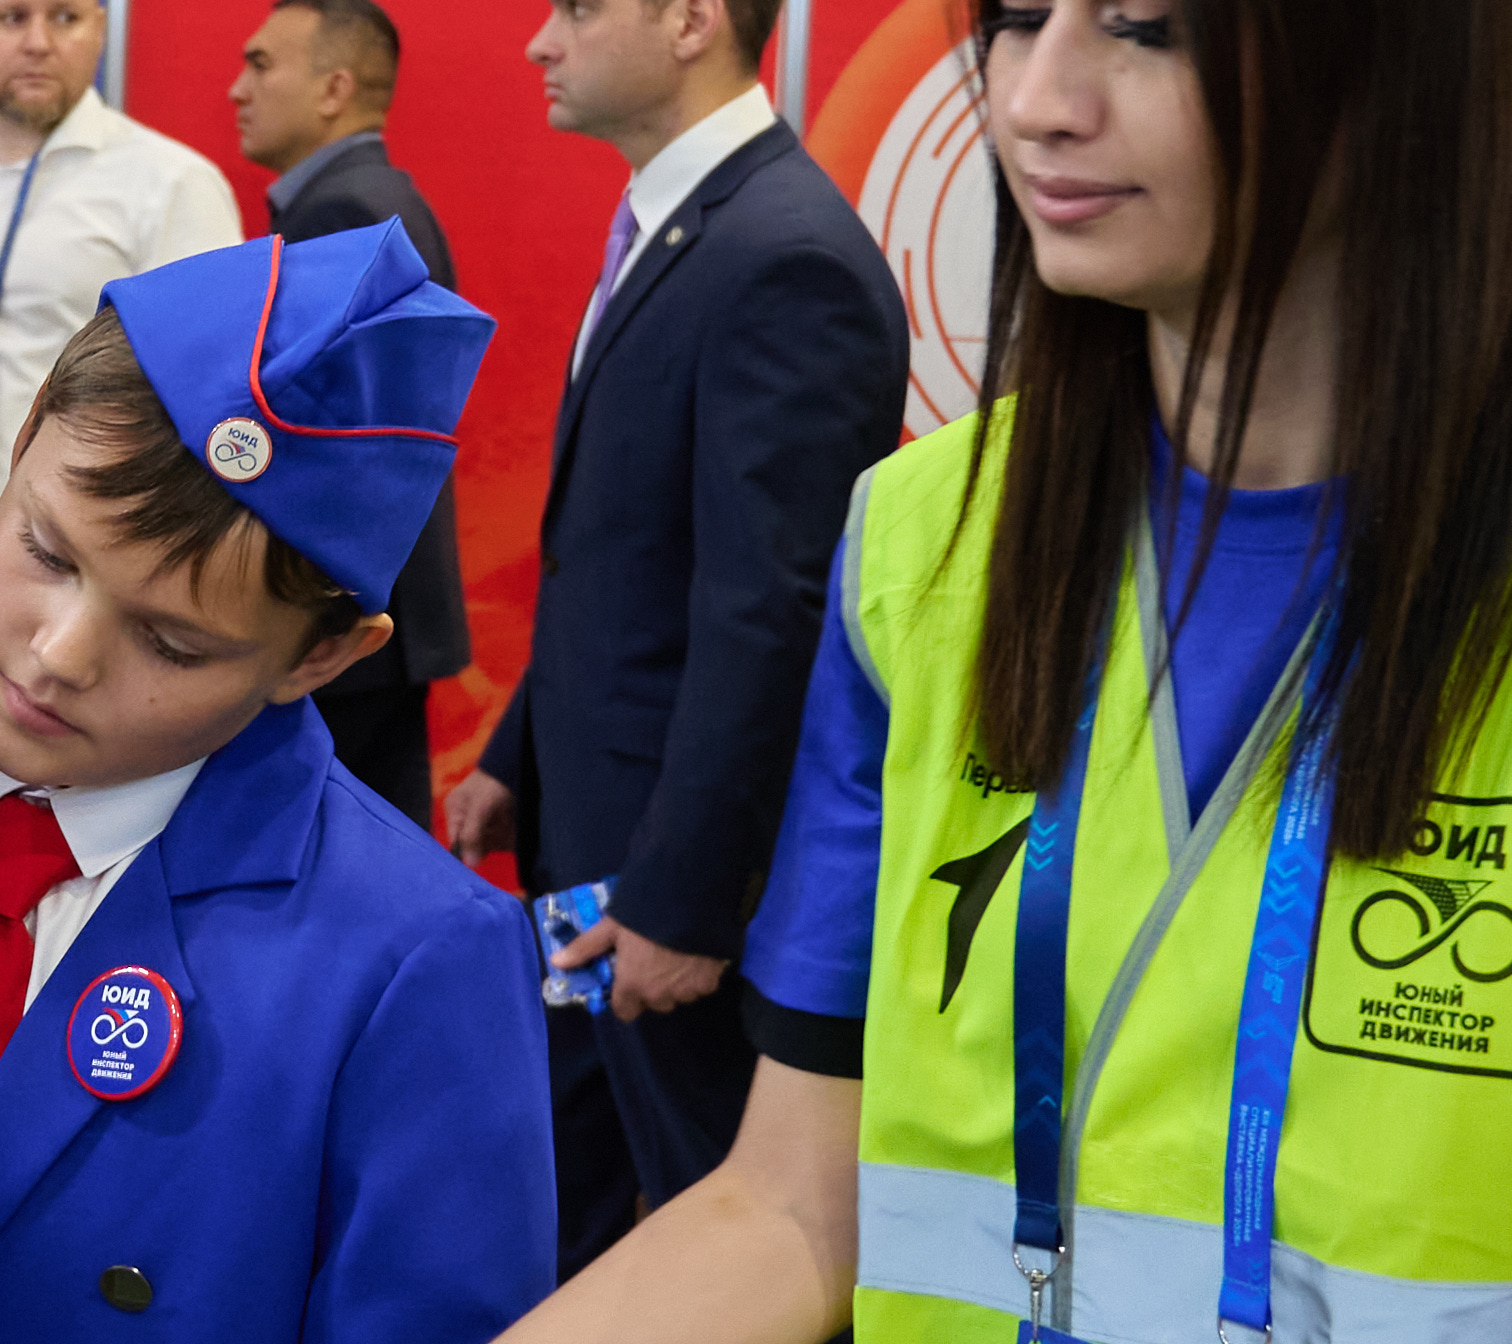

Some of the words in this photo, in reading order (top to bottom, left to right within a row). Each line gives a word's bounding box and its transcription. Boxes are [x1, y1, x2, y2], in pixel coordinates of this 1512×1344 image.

[228, 427, 258, 448] ЮИД
[101, 985, 150, 1010] ЮИД
[1394, 982, 1463, 1007] ЮНЫЙ
[1359, 998, 1495, 1032] ИНСПЕКТОР
[1359, 1020, 1489, 1054] ДВИЖЕНИЯ
[91, 1058, 135, 1070] ИНСПЕКТОР
[91, 1068, 132, 1081] ДВИЖЕНИЯ
